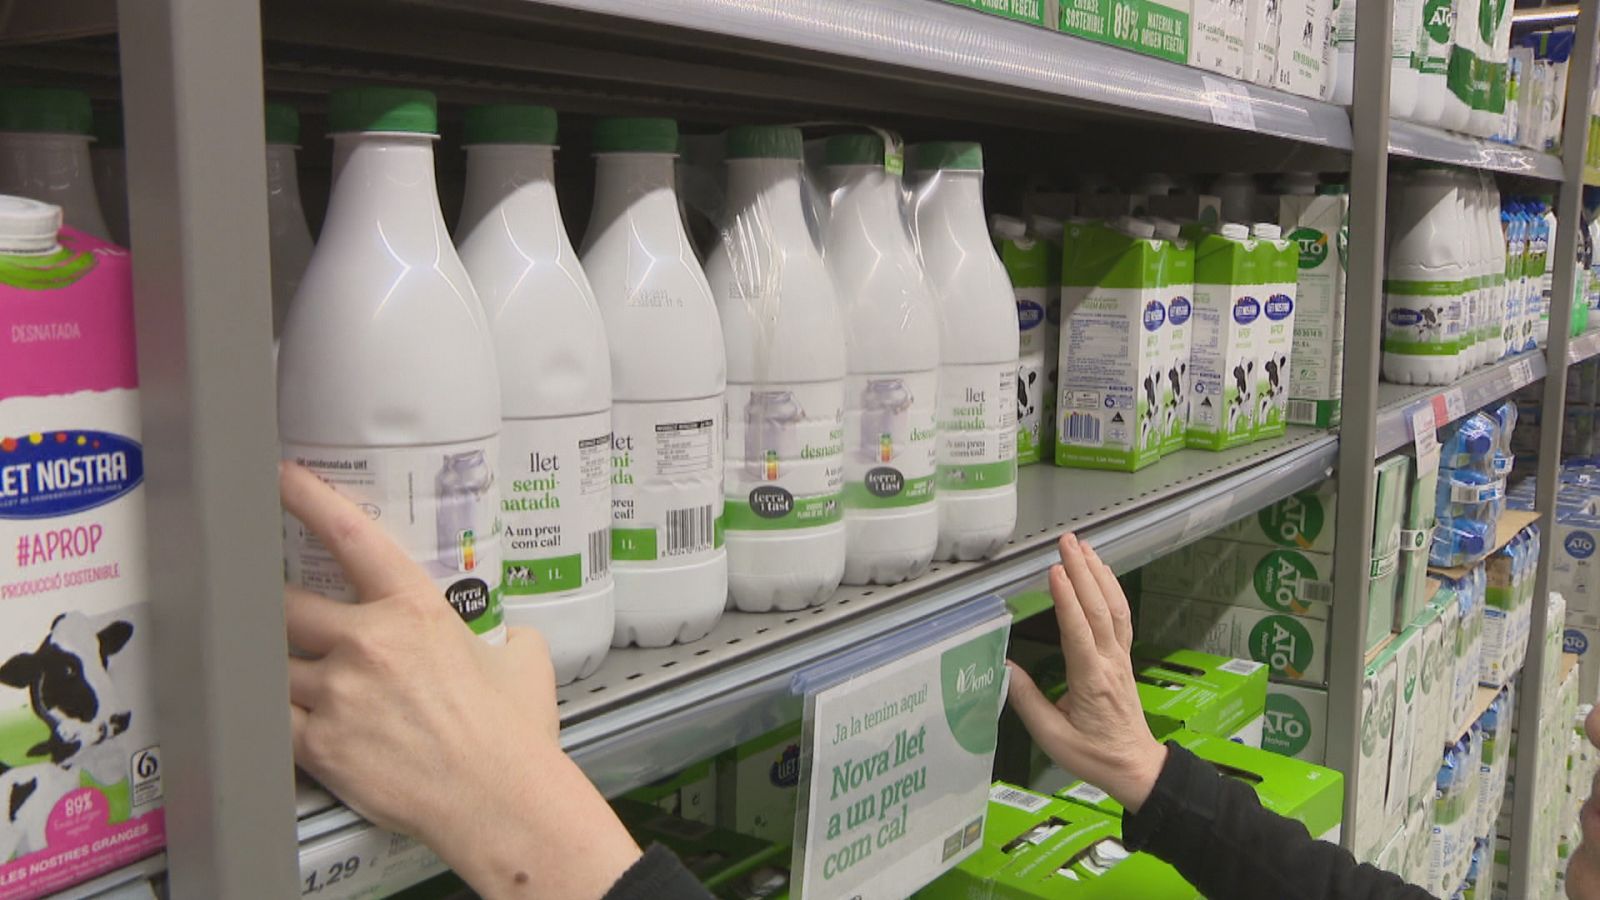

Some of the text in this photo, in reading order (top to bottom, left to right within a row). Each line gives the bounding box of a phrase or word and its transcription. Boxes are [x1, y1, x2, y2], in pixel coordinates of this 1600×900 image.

[1066, 7, 1105, 35] SOSTENIBLE
[1114, 2, 1139, 42] 89%
[1147, 11, 1174, 34] MATERIAL
[1141, 28, 1163, 49] ORIGEN
[11, 322, 81, 343] DESNATADA
[966, 387, 985, 403] llet
[610, 431, 634, 451] let
[0, 451, 128, 497] ET NOSTRA
[530, 452, 560, 473] llet
[512, 473, 561, 493] semi-
[754, 491, 785, 503] terra
[614, 508, 635, 520] cal!
[504, 525, 561, 538] A un preu
[511, 535, 561, 549] com cal!
[1567, 538, 1593, 551] ATO
[17, 523, 103, 568] #APROP
[0, 562, 121, 600] PRODUCCIÓ SOSTENIBLE
[450, 586, 482, 602] terra
[1275, 555, 1301, 606] ATO
[1270, 620, 1297, 671] ATO
[832, 723, 848, 745] Ja
[850, 716, 861, 737] la
[864, 701, 899, 731] tenim
[830, 725, 926, 801] Nova llet
[65, 790, 93, 817] 89%
[827, 766, 926, 840] a un preu
[29, 844, 90, 874] NOSTRES
[91, 823, 149, 852] GRANGES
[823, 833, 872, 880] com
[876, 803, 908, 849] cal
[301, 855, 361, 896] 1,29
